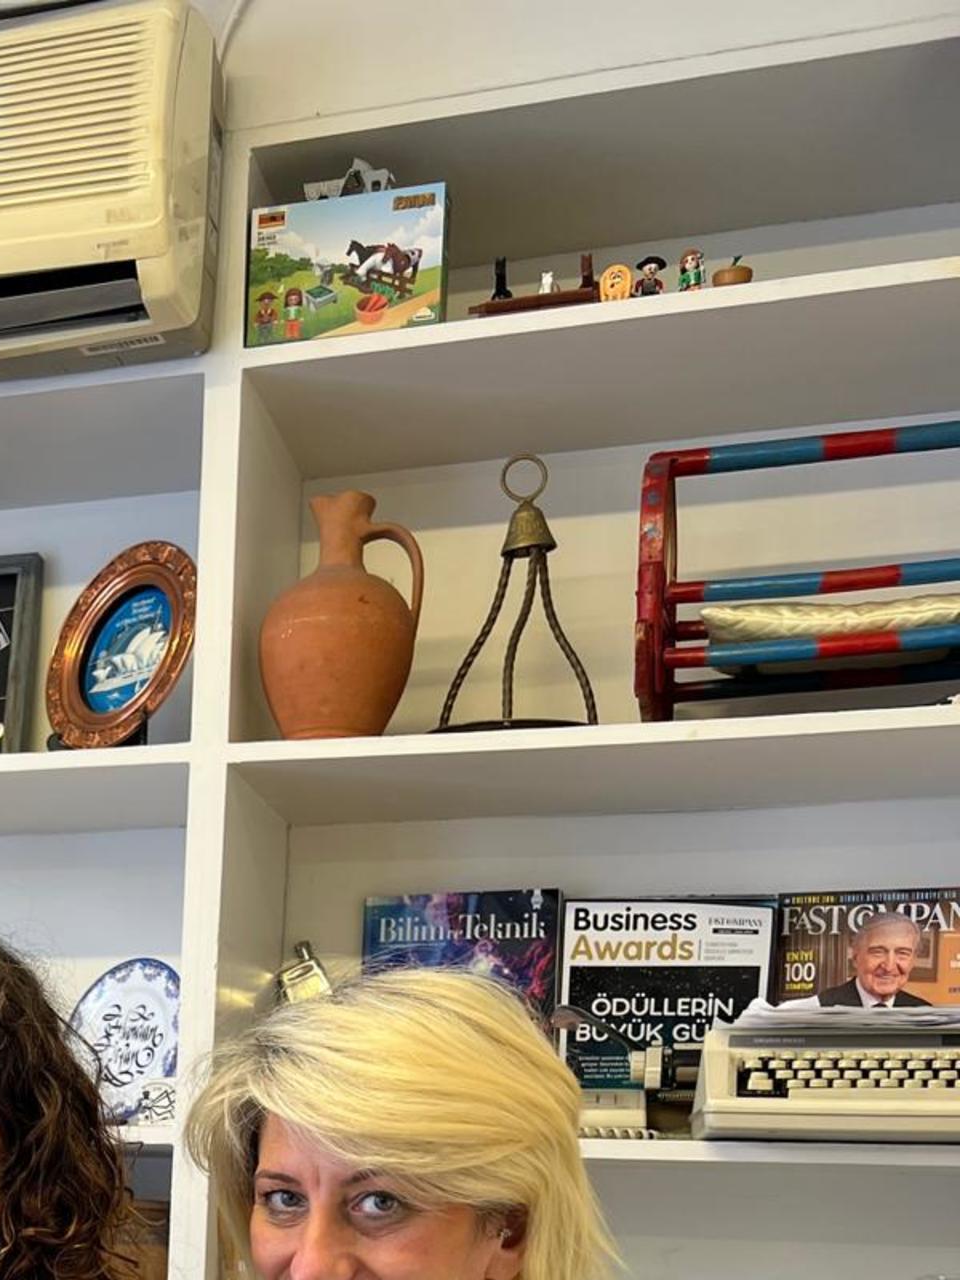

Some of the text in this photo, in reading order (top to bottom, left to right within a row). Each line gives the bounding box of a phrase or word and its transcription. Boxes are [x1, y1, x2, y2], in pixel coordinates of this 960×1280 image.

[378, 916, 444, 943] Bilim
[458, 911, 546, 941] Teknik
[573, 906, 697, 931] Business
[781, 904, 847, 936] FAST
[570, 933, 694, 961] Awards
[784, 962, 815, 982] 100
[591, 992, 734, 1017] ÖDÜLLERİN
